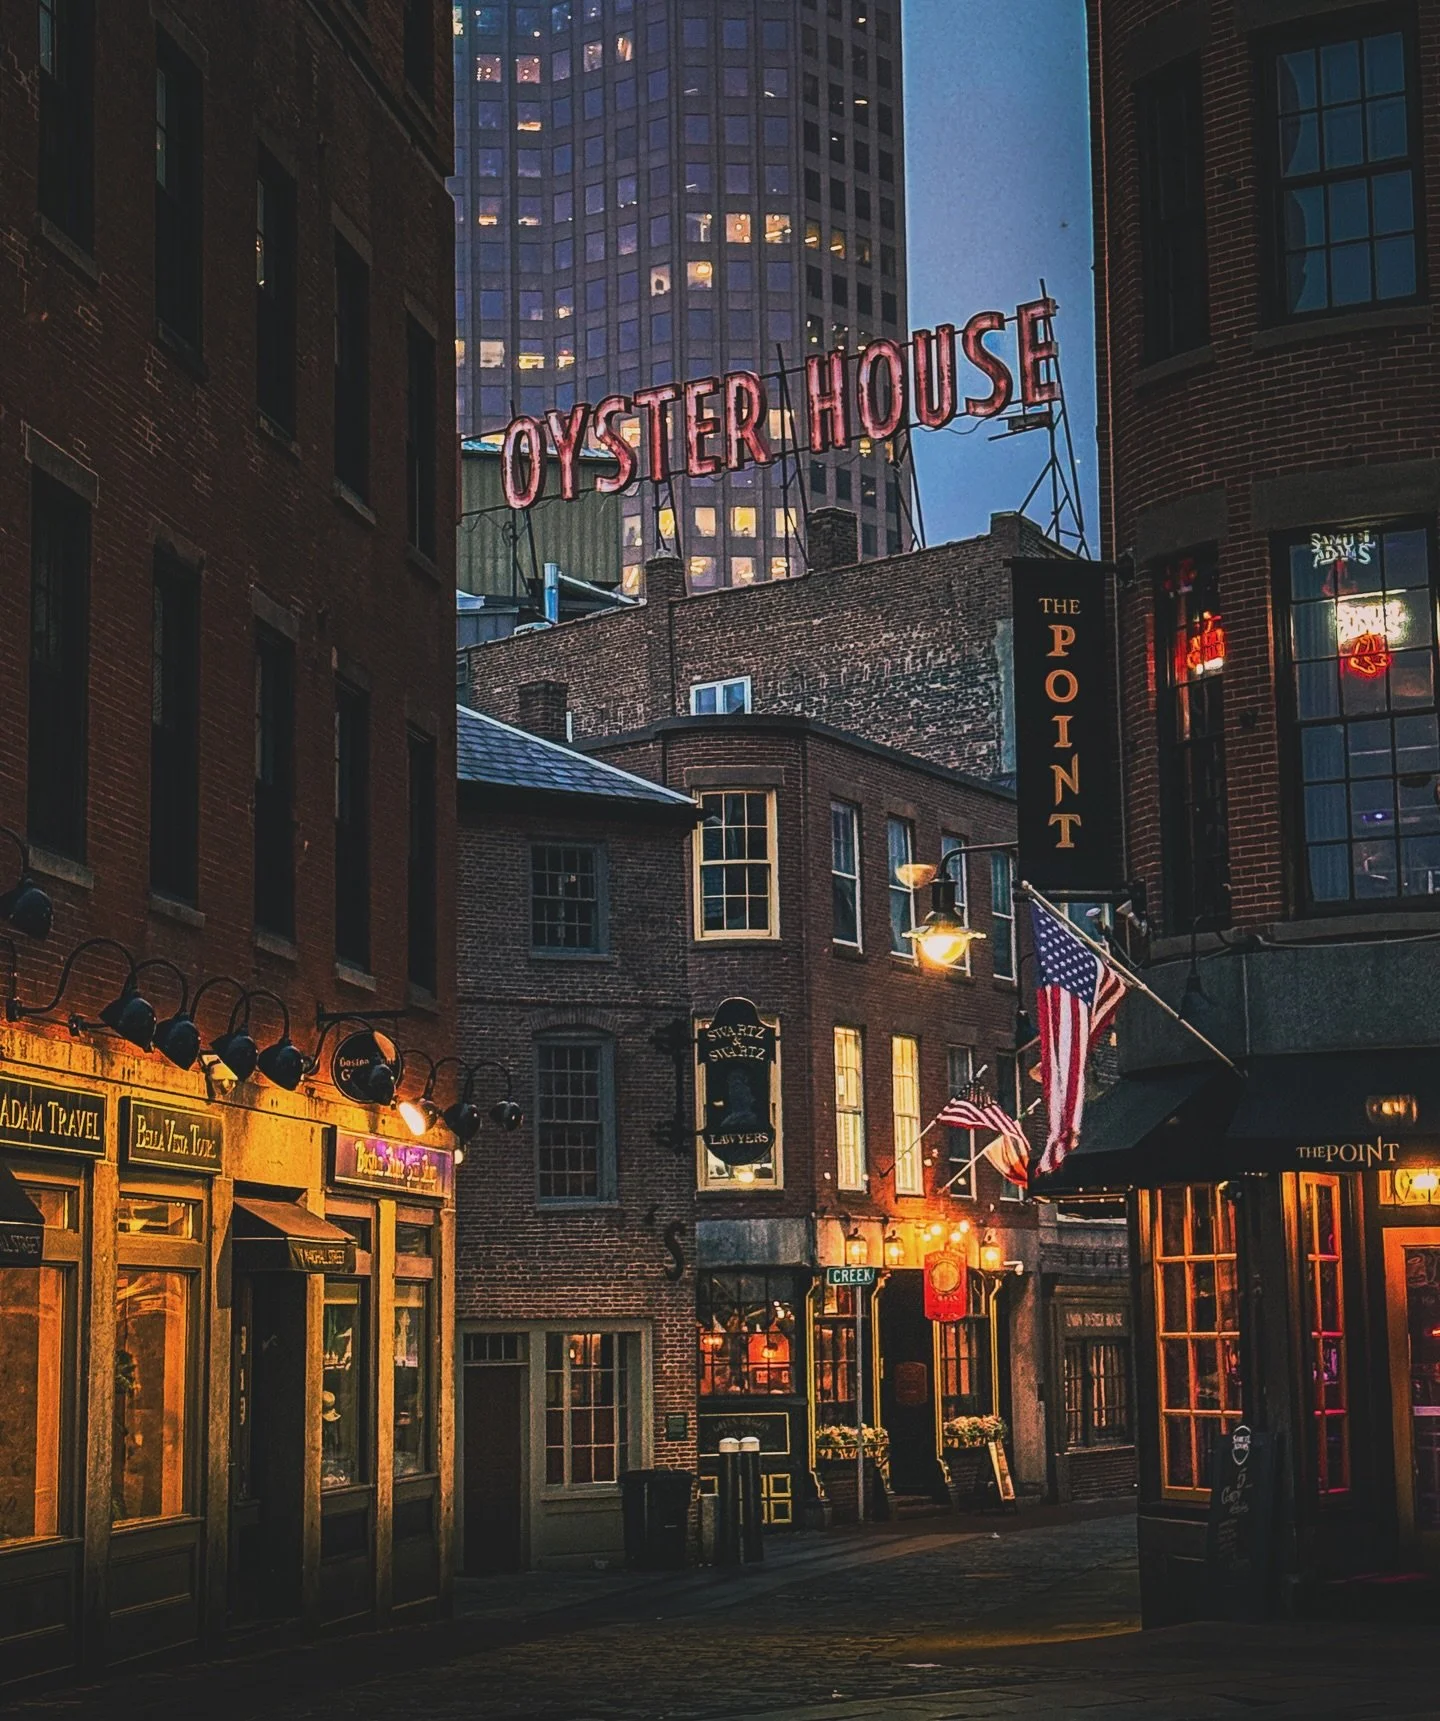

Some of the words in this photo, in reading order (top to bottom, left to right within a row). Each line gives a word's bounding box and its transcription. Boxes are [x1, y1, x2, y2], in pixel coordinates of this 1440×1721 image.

[502, 371, 768, 510] OYSTER
[805, 297, 1060, 454] HOUSE
[1038, 598, 1081, 615] THE
[1045, 623, 1082, 848] POINT
[706, 1023, 767, 1042] SWARTZ
[708, 1045, 766, 1062] SWARTZ
[47, 1100, 101, 1141] TRAVEL
[709, 1132, 769, 1145] LAWYERS
[833, 1268, 872, 1283] CREEK
